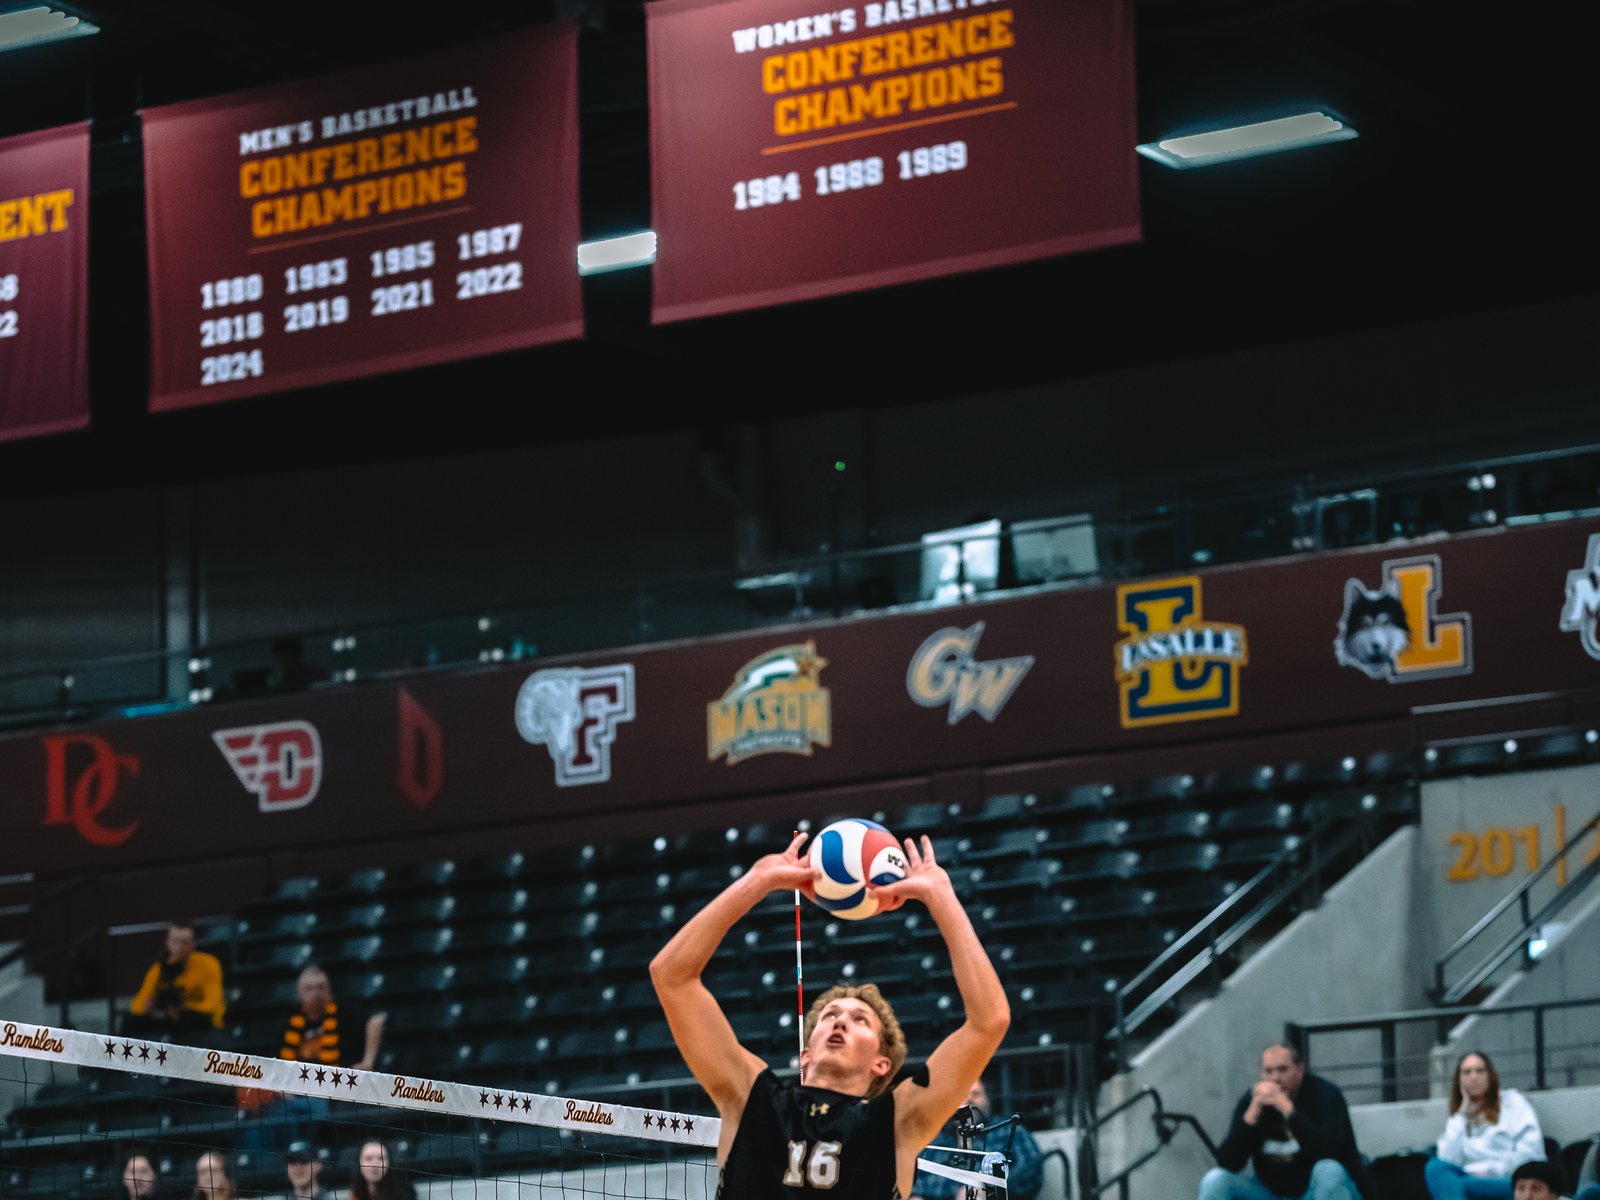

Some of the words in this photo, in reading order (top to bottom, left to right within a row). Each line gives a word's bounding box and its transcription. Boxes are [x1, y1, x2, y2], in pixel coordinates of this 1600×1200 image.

[732, 8, 857, 53] WOMEN'S
[864, 0, 1002, 27] BASKE
[762, 9, 1015, 94] CONFERENCE
[239, 120, 313, 156] MEN'S
[321, 86, 478, 139] BASKETBALL
[774, 56, 1004, 136] CHAMPIONS
[239, 116, 478, 198] CONFERENCE
[732, 171, 801, 210] 1984
[814, 156, 884, 195] 1988
[897, 140, 968, 180] 1989
[251, 160, 467, 239] CHAMPIONS
[370, 240, 434, 278] 1985
[457, 222, 522, 260] 1987
[200, 311, 264, 347] 2018
[284, 295, 349, 332] 2019
[371, 279, 434, 316] 2021
[456, 261, 523, 299] 2022
[200, 349, 263, 386] 2024
[708, 689, 831, 745] MASON
[1446, 823, 1540, 882] 201
[1, 1023, 64, 1053] Ramblers
[204, 1051, 264, 1080] Ramblers
[390, 1076, 445, 1103] Ramblers
[563, 1100, 614, 1126] Ramblers
[783, 1140, 843, 1189] 16
